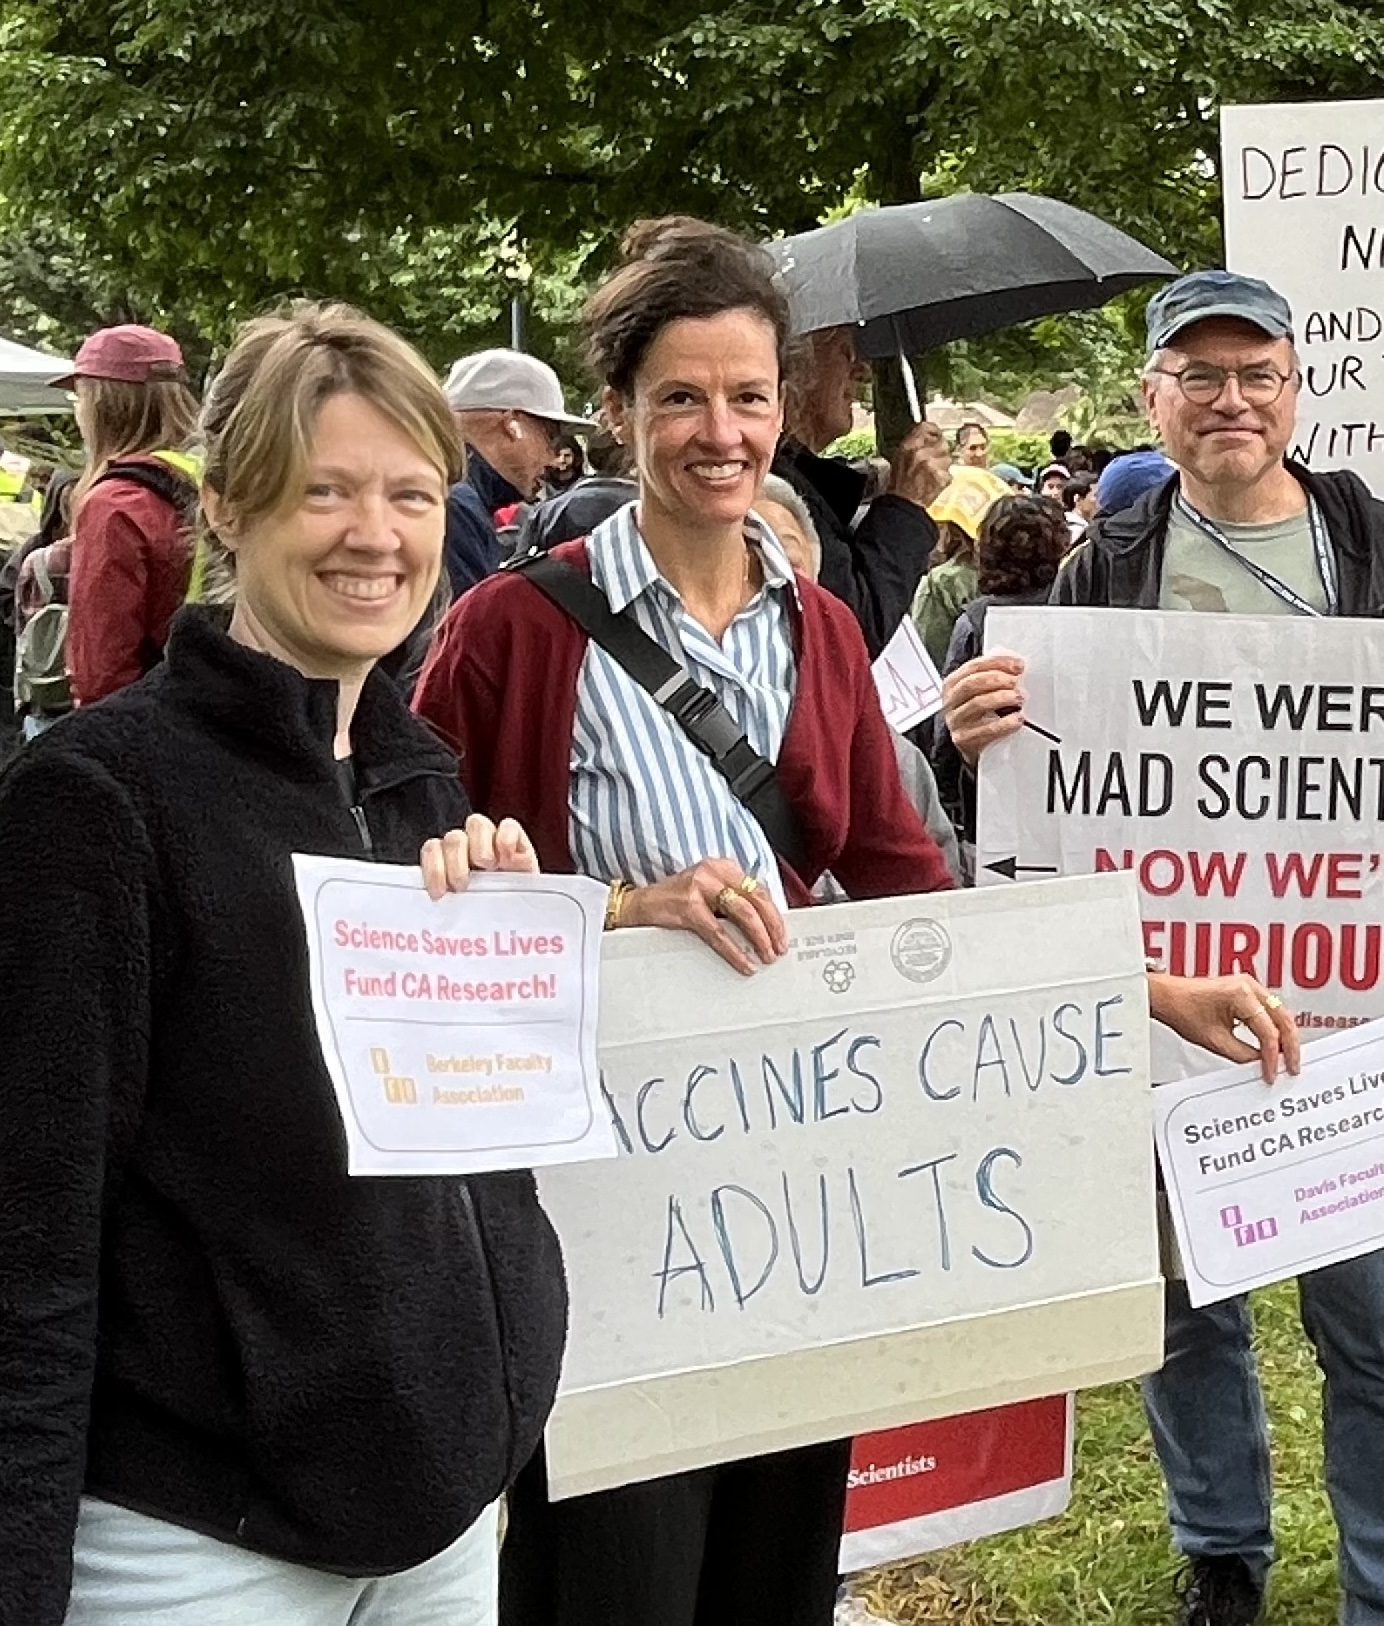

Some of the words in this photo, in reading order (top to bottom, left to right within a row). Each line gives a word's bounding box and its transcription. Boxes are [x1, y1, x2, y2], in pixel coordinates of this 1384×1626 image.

[1304, 307, 1382, 344] AND
[1296, 355, 1367, 397] UR
[1133, 680, 1232, 728] WE
[1045, 750, 1173, 817] MAD
[334, 920, 418, 952] Science
[421, 929, 488, 957] Saves
[494, 930, 564, 956] Lives
[344, 969, 396, 997] Fund
[401, 973, 432, 1000] CA
[437, 973, 557, 1001] Research!
[919, 994, 1133, 1102] CAUSE
[1184, 1106, 1276, 1145] Science
[1279, 1084, 1345, 1117] Saves
[1199, 1143, 1255, 1175] Fund
[1260, 1132, 1294, 1157] CA
[1294, 1180, 1336, 1202] Davis
[652, 1147, 1033, 1317] ADULTS
[846, 1456, 936, 1489] Scientists
